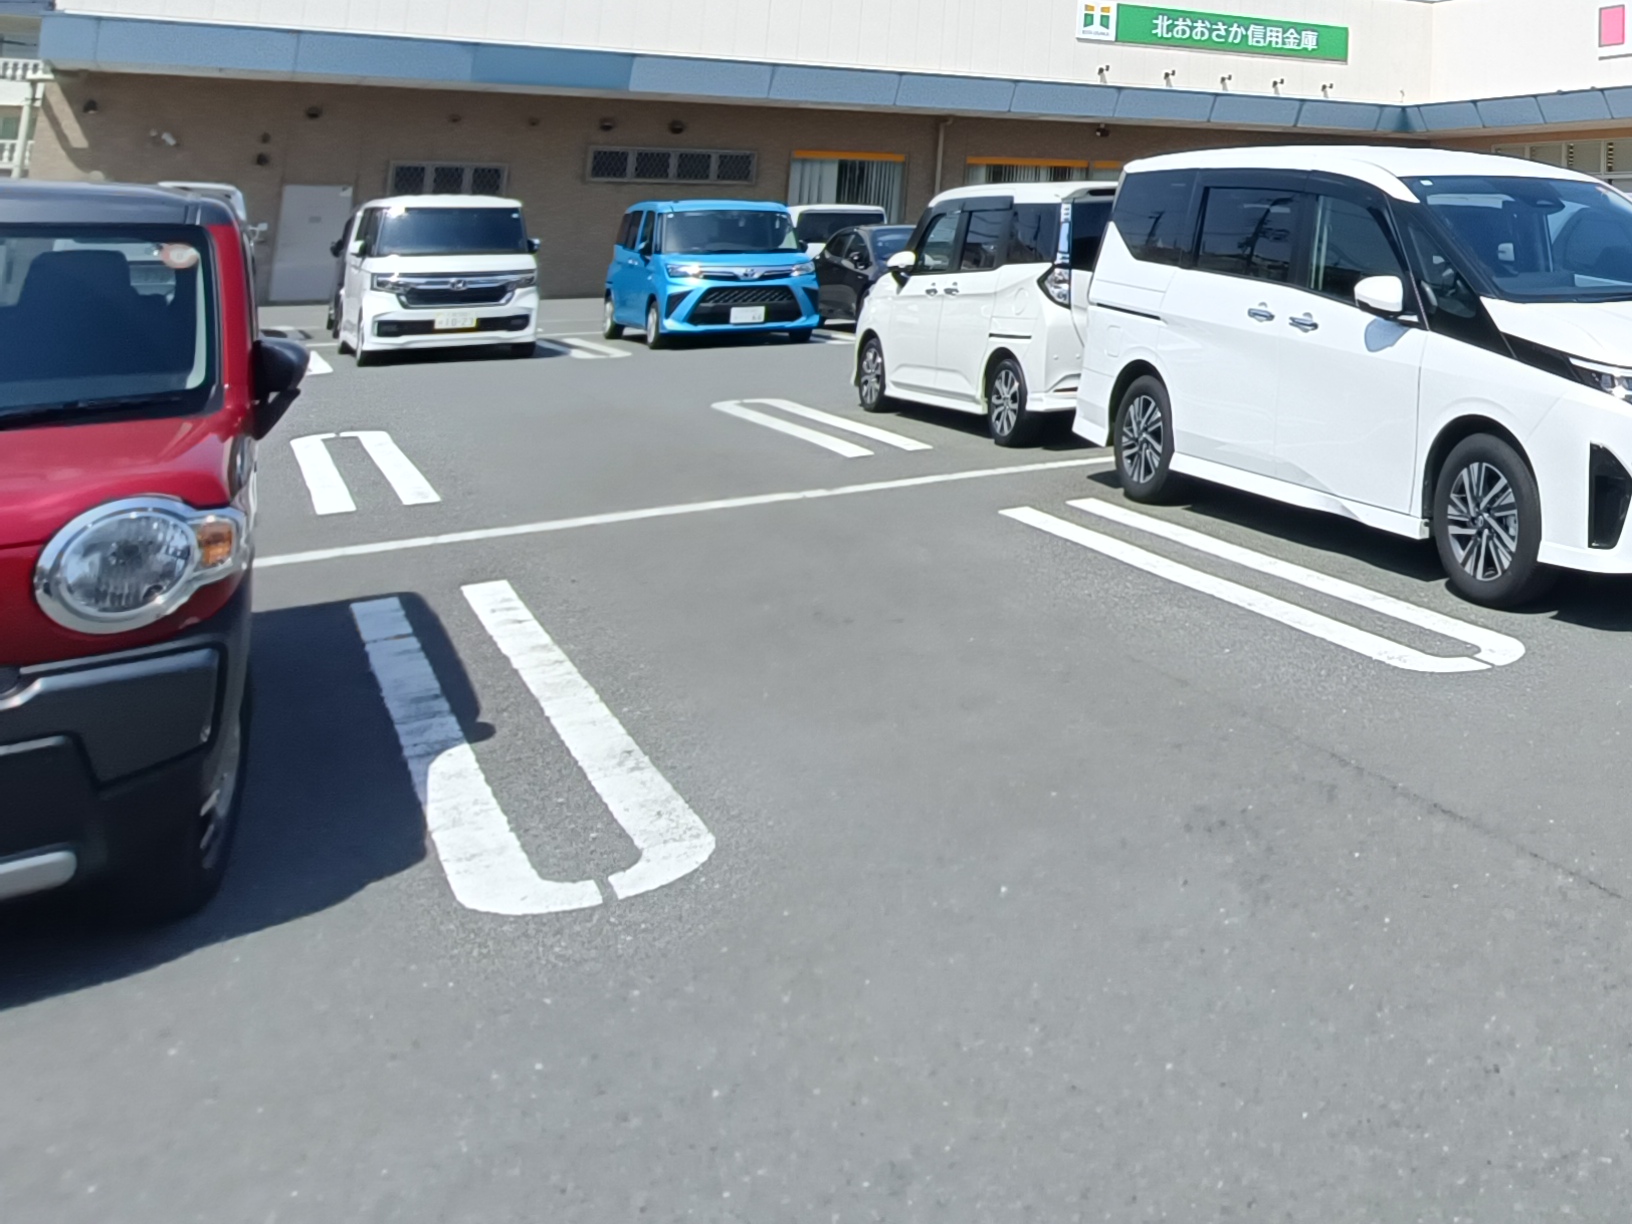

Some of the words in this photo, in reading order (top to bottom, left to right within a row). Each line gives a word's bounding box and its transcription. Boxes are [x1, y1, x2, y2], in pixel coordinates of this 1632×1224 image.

[1152, 15, 1319, 51] 北おおさか信用金庫
